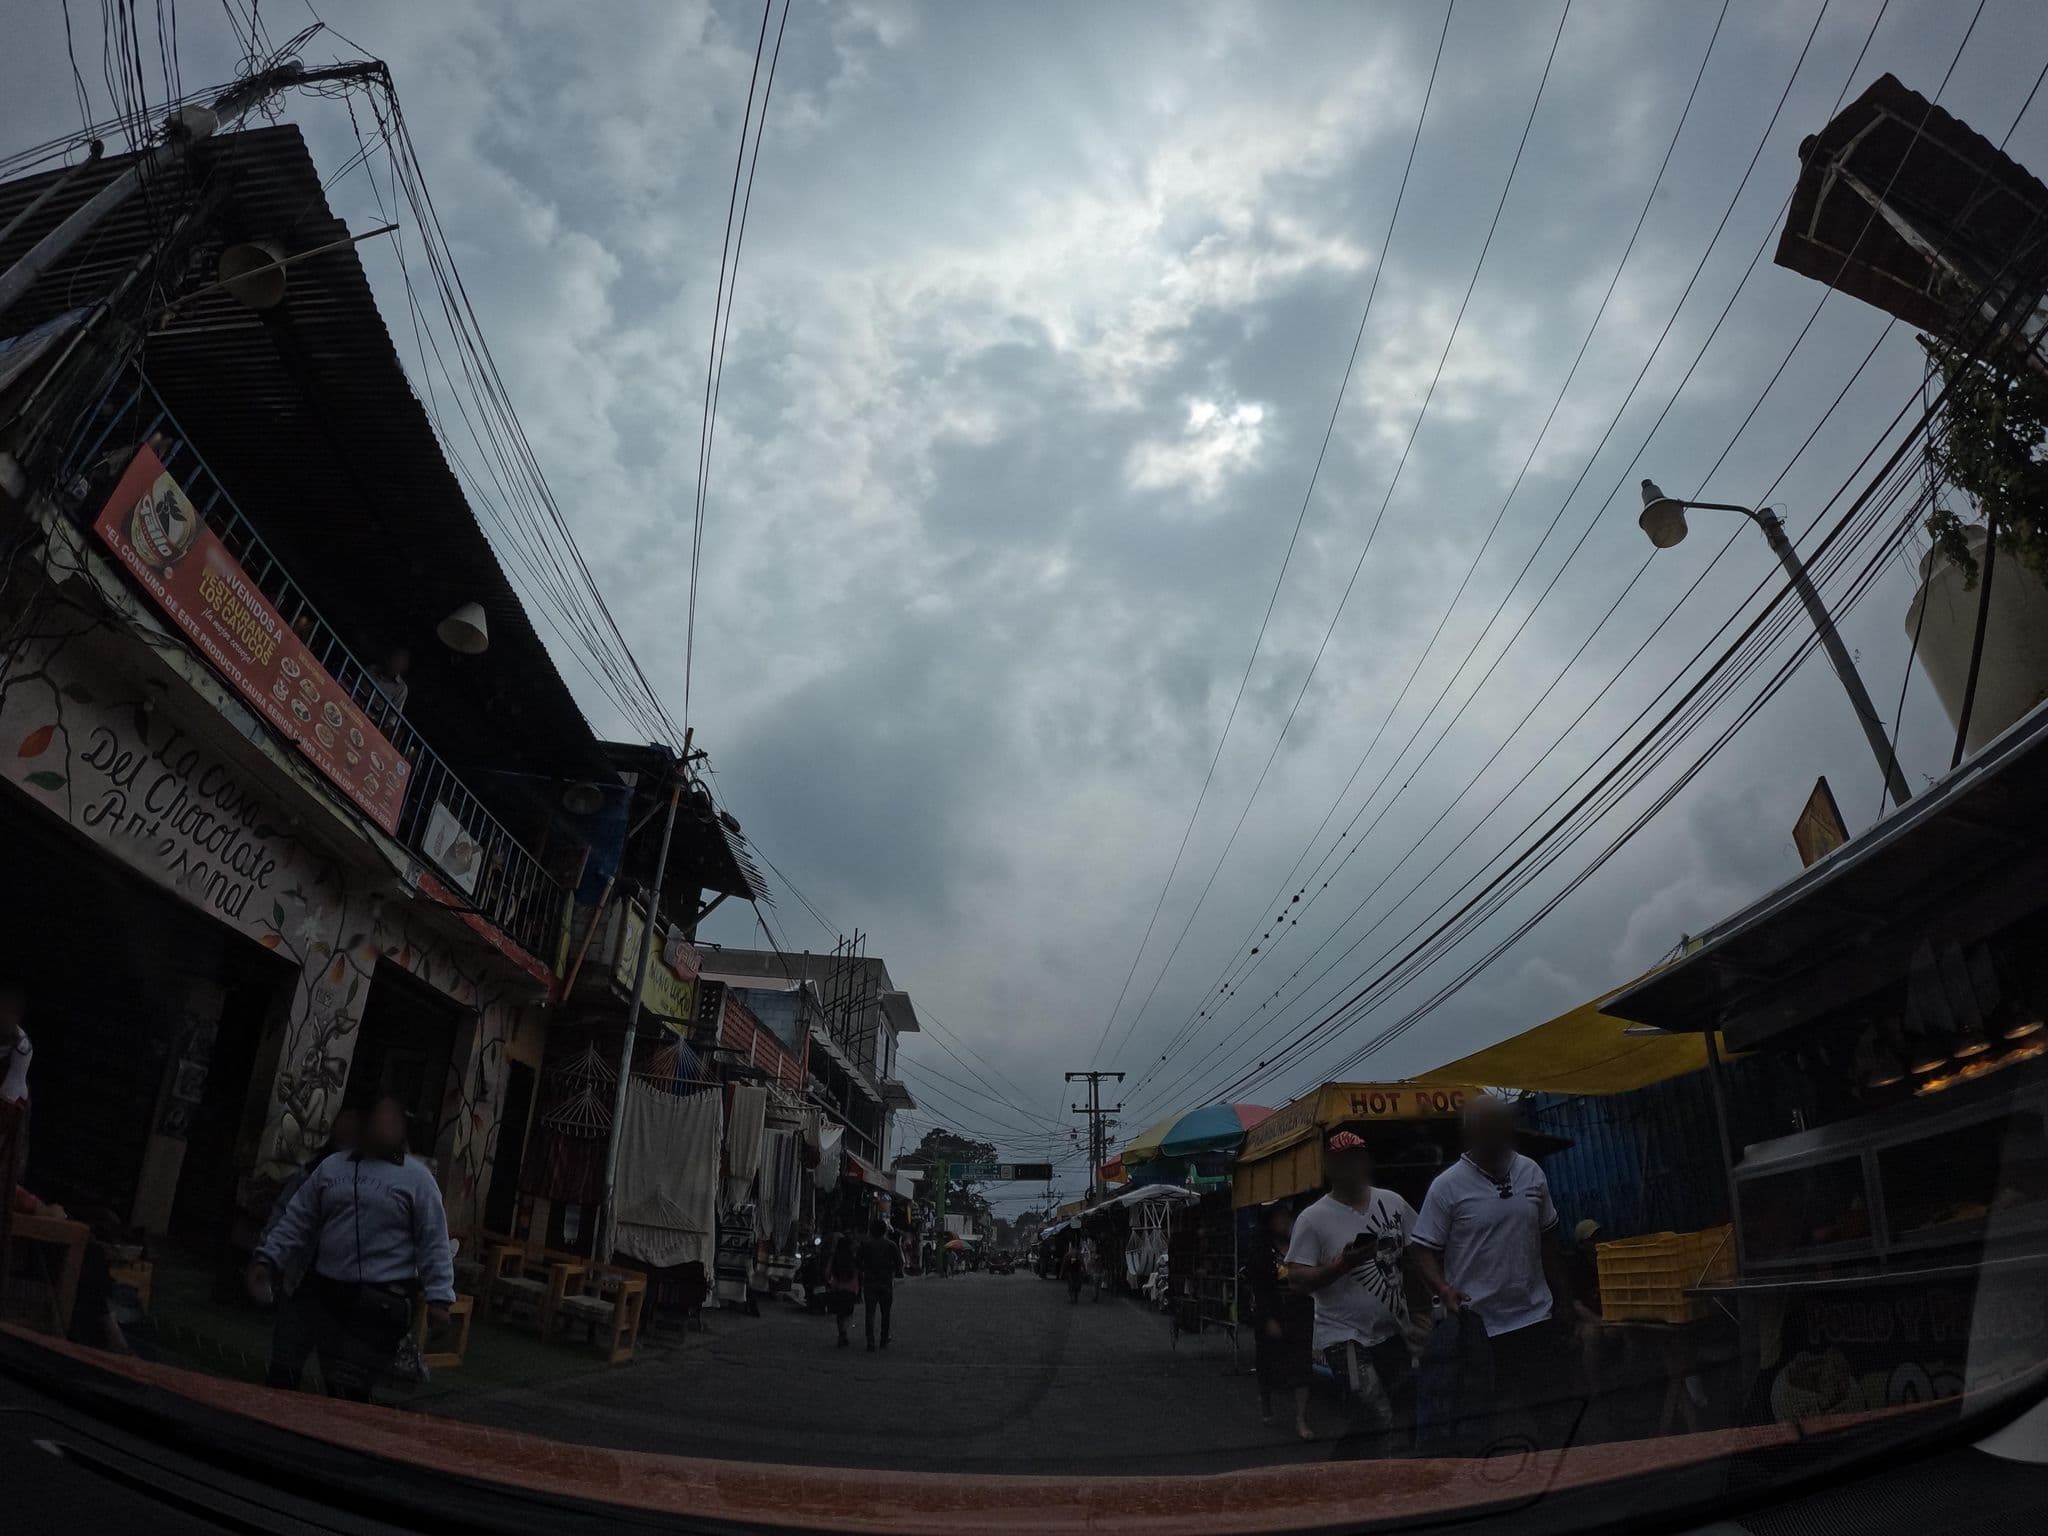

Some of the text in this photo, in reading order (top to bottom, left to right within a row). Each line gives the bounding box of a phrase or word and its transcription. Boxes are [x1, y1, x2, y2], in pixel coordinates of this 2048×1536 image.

[120, 544, 165, 597] CONSUMO
[177, 606, 200, 637] ESTE
[199, 633, 243, 681] PRODUCTO
[241, 679, 268, 707] CAUSA
[200, 581, 270, 667] LOS CAYUCOS
[273, 628, 283, 643] A
[81, 726, 275, 889] Del Chocolate
[1350, 1092, 1401, 1114] HOT
